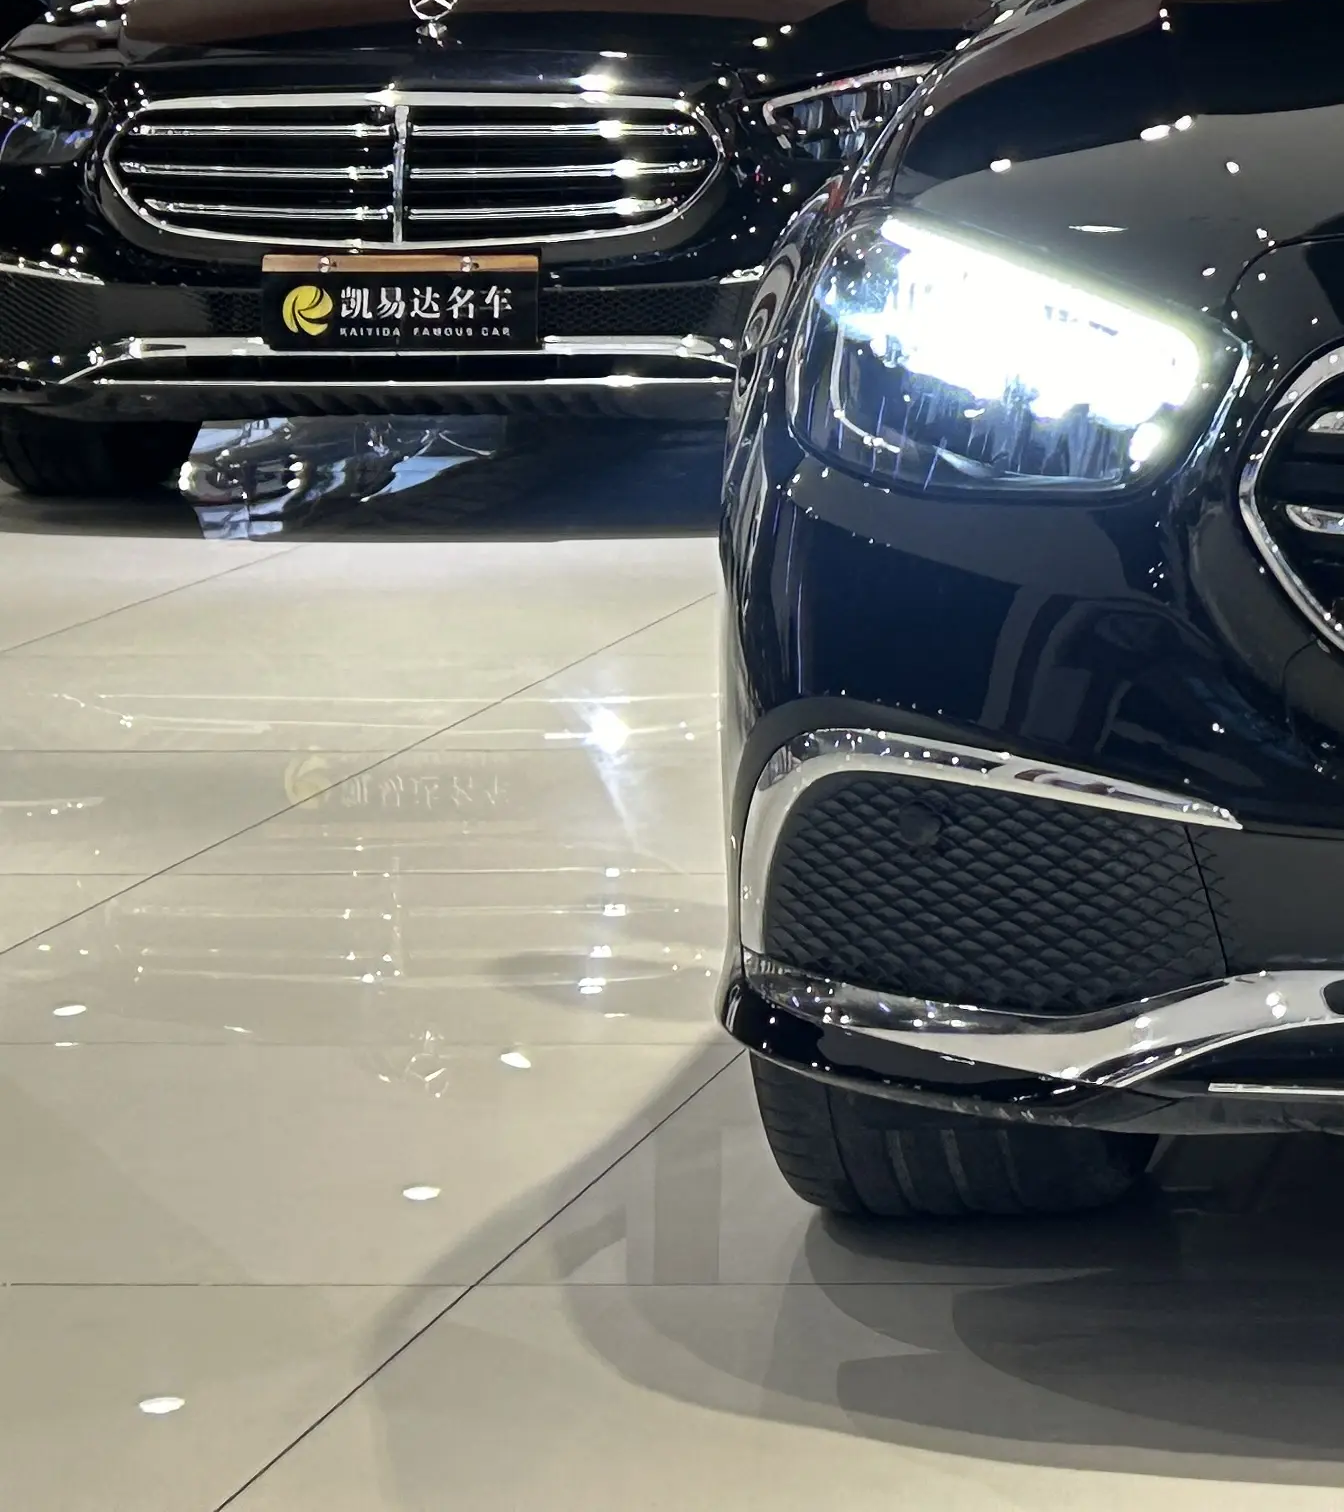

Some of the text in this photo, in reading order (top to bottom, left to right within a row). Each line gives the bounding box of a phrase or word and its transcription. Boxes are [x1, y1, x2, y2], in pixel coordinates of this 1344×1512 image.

[340, 285, 513, 320] 凯易达名车
[480, 326, 511, 337] CAR
